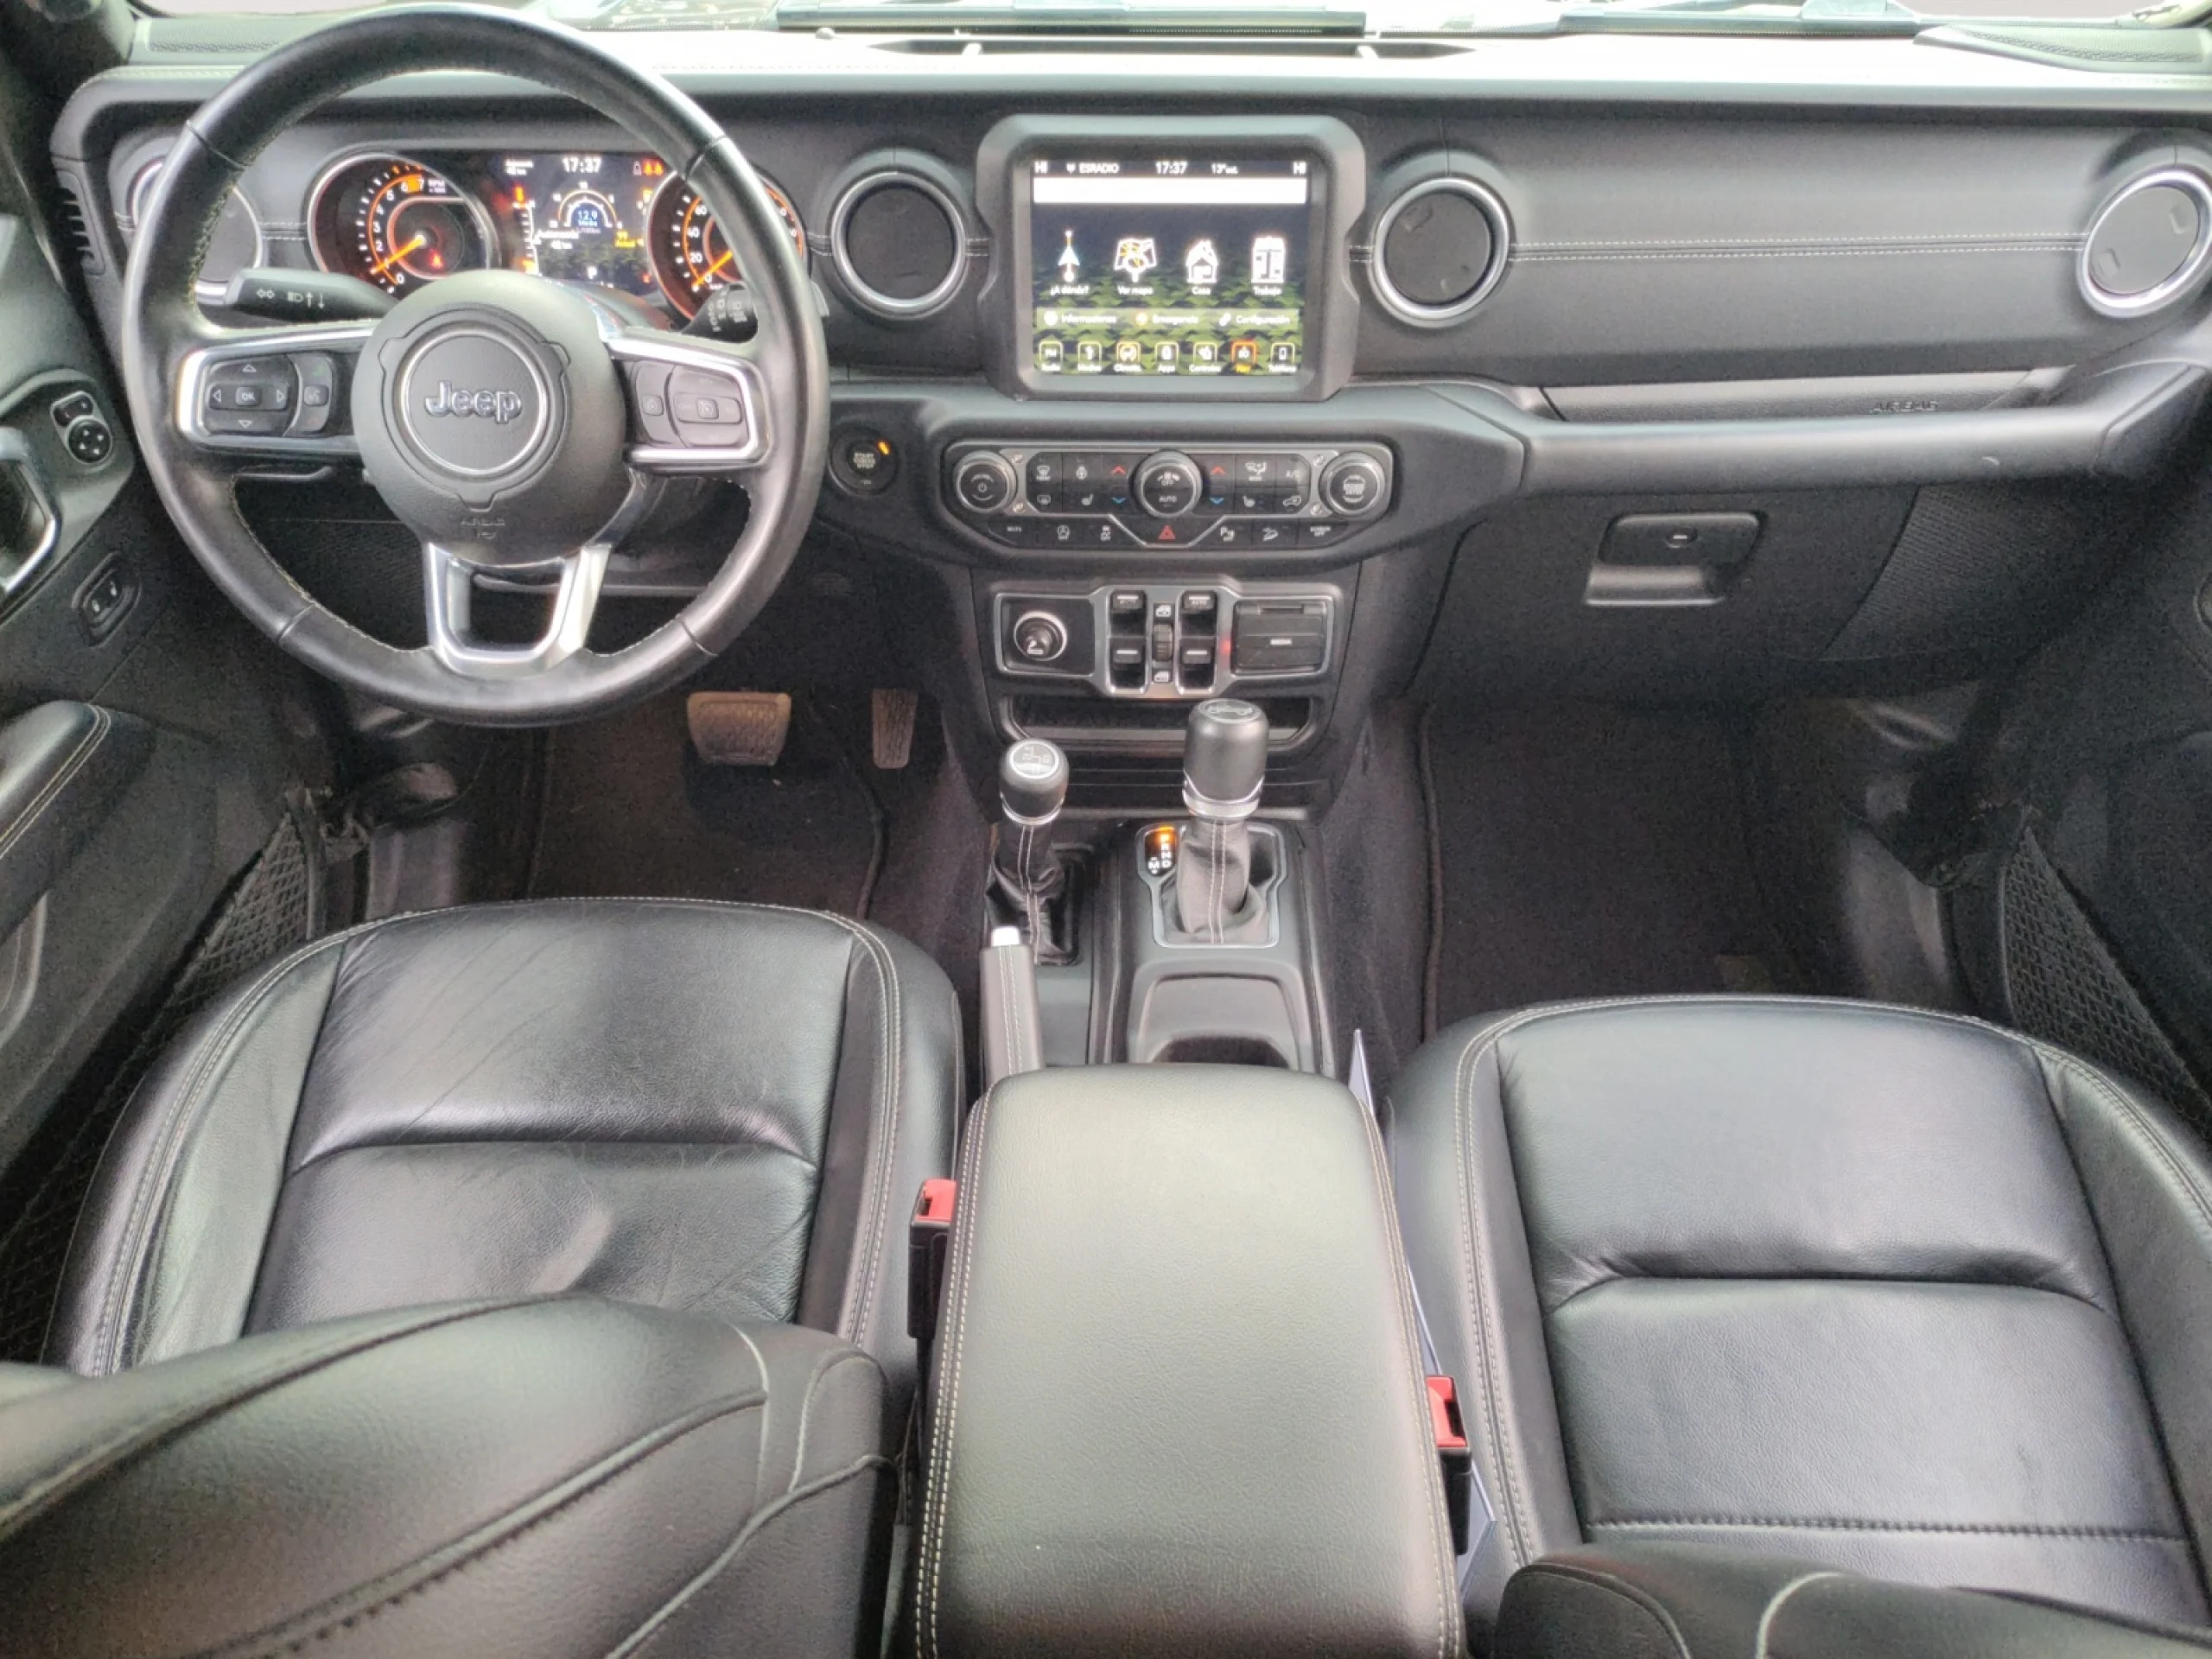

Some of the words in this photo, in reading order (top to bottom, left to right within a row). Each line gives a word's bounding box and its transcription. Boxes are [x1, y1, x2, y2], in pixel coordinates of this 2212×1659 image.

[563, 156, 602, 173] 17:37
[1034, 161, 1048, 174] HI
[1155, 161, 1188, 175] 17:37
[1293, 161, 1307, 175] HI
[400, 182, 409, 193] 6
[416, 178, 425, 191] 7
[387, 189, 395, 201] 5
[372, 221, 381, 233] 3
[375, 239, 384, 251] 2
[690, 251, 702, 263] 20
[396, 272, 405, 284] 0
[241, 392, 256, 402] OK
[424, 380, 522, 424] Jeep
